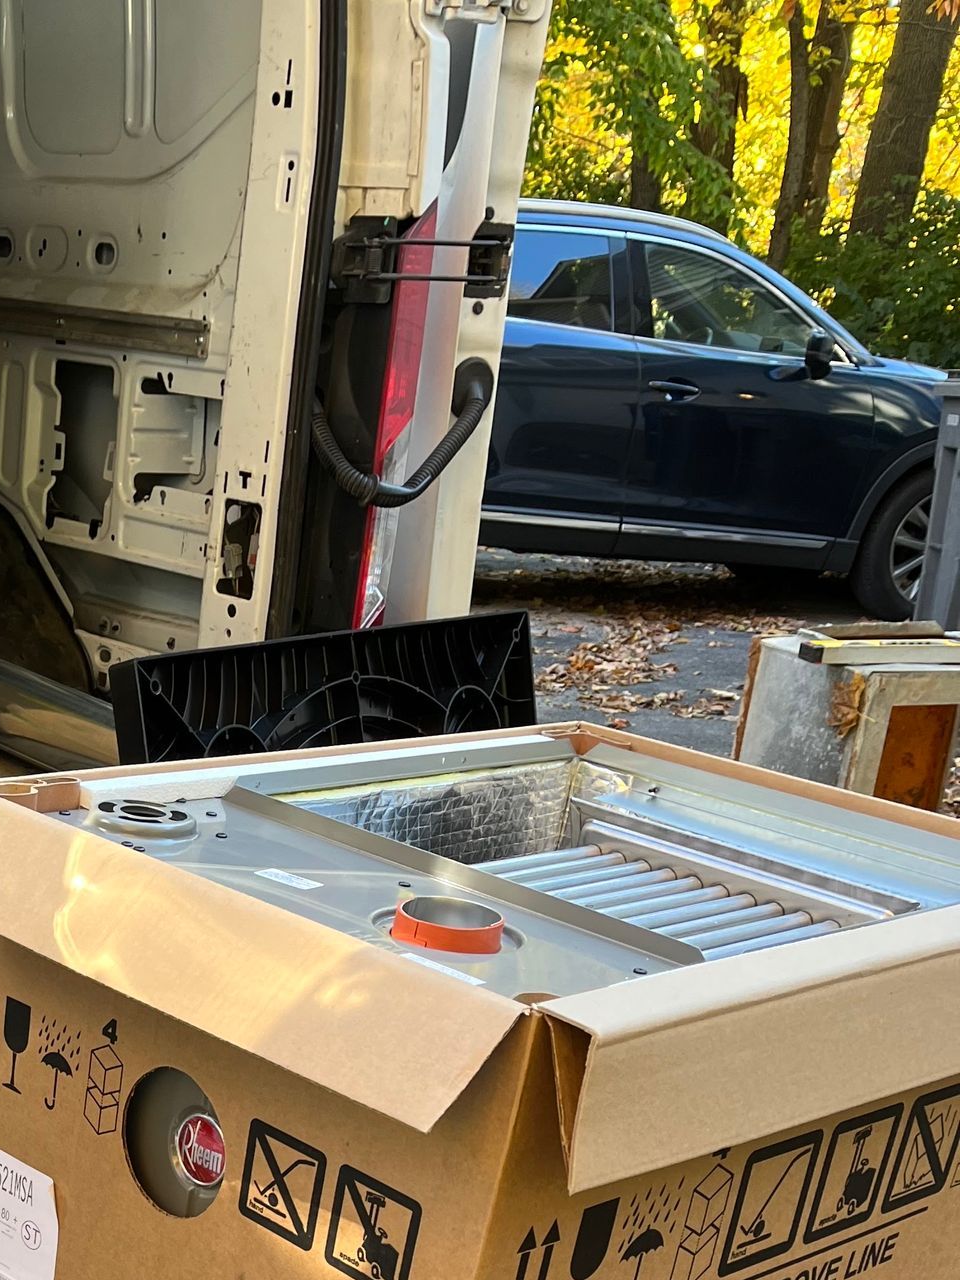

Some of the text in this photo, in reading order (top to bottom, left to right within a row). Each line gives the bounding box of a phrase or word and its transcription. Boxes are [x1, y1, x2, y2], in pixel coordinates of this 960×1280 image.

[102, 1018, 118, 1045] 4
[181, 1119, 223, 1174] Rheem
[248, 1199, 264, 1214] hand
[23, 1223, 40, 1245] ST
[339, 1251, 360, 1268] spade
[844, 1231, 900, 1280] LINE
